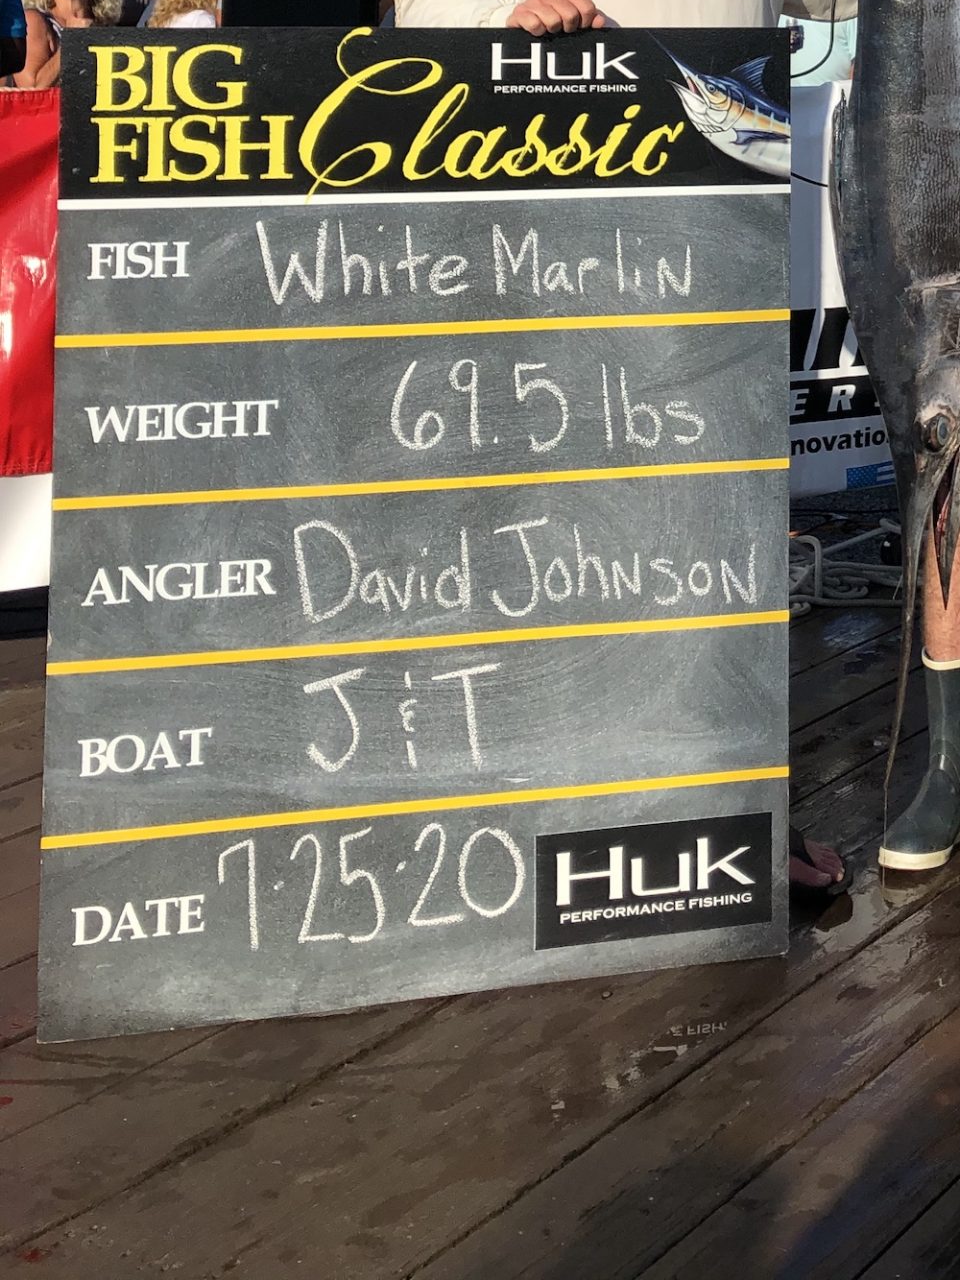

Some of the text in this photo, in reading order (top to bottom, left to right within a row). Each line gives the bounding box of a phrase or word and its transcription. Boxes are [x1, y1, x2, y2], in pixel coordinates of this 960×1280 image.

[88, 44, 248, 112] BIG
[494, 84, 637, 94] PERFORMANCE FISHING
[88, 28, 685, 204] FISH Classic
[87, 241, 191, 280] FISH
[256, 217, 469, 306] White
[84, 399, 279, 444] WEIGHT
[390, 358, 705, 455] 69.5 lbs
[790, 425, 889, 456] novatio
[80, 557, 277, 607] ANGLER
[294, 520, 471, 622] David
[303, 667, 364, 772] J
[437, 662, 503, 770] T
[78, 728, 213, 778] BOAT
[70, 892, 206, 947] DATE
[560, 892, 752, 924] PERFORMANCE FISHING
